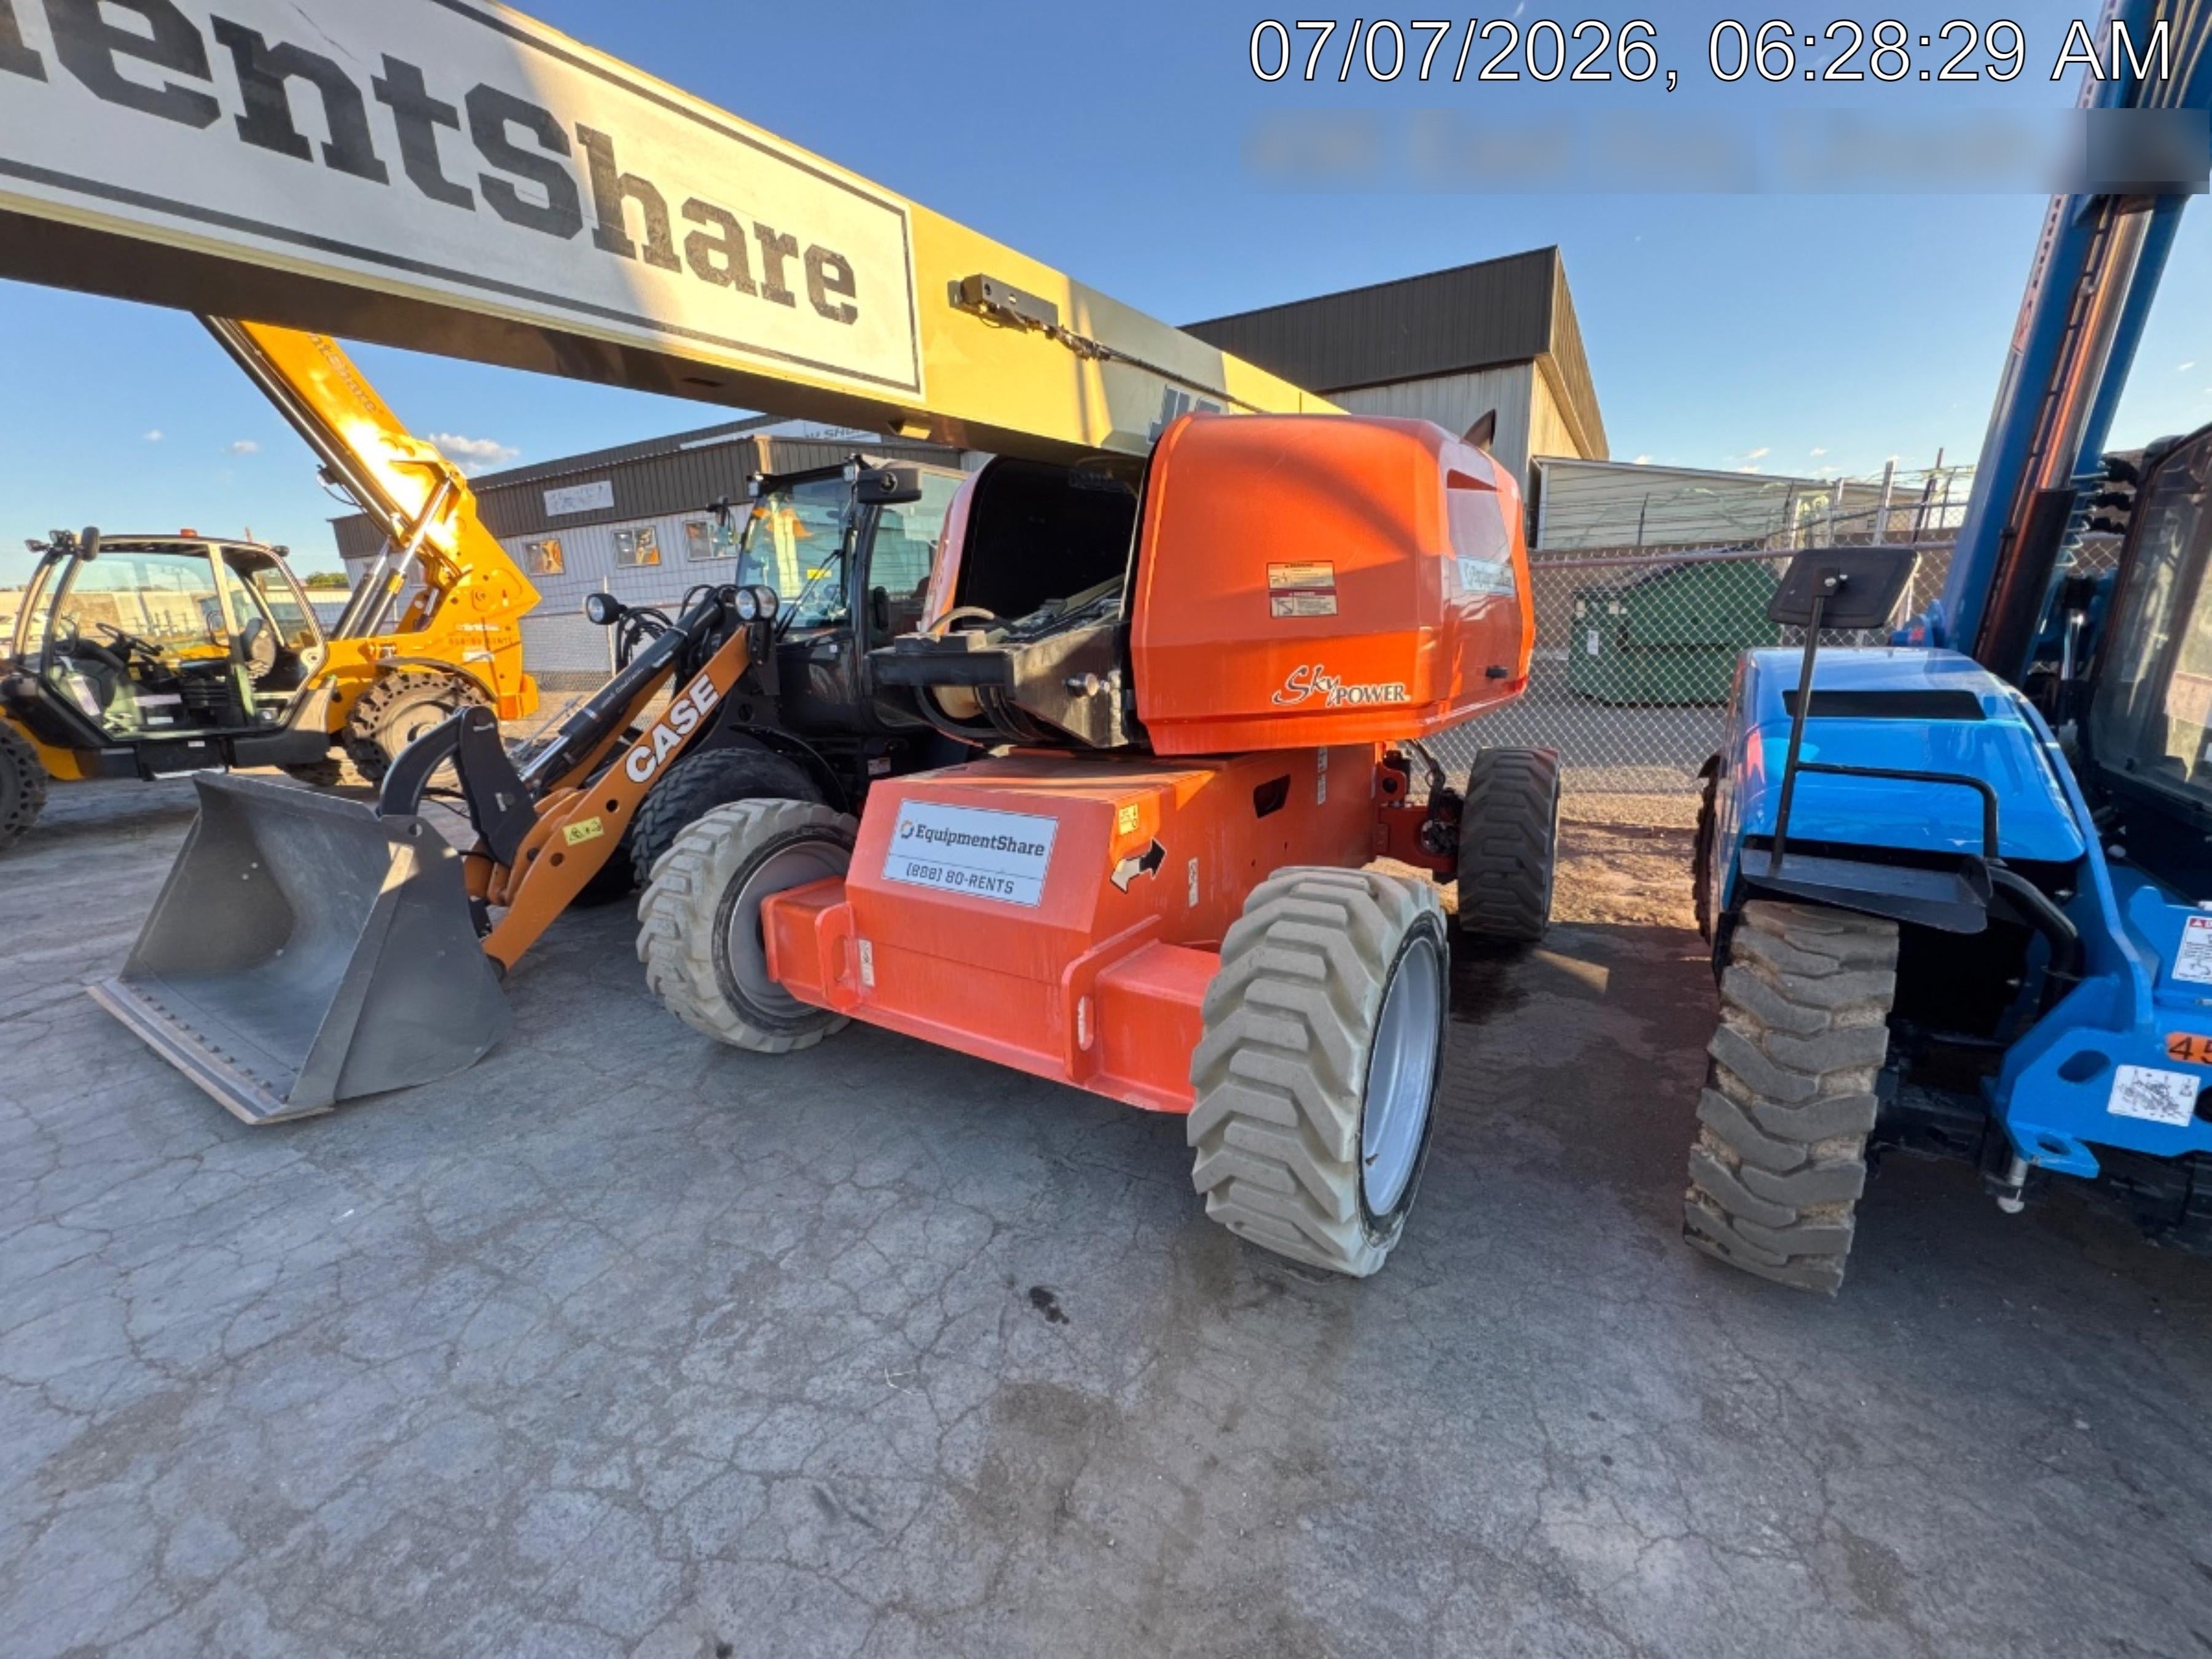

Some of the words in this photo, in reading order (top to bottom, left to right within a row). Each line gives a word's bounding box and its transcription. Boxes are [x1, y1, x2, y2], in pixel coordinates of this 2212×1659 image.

[0, 0, 858, 325] entShare
[626, 673, 720, 783] CASE
[916, 823, 1045, 857] EquipmentShare
[945, 865, 1014, 895] 80-RENTS
